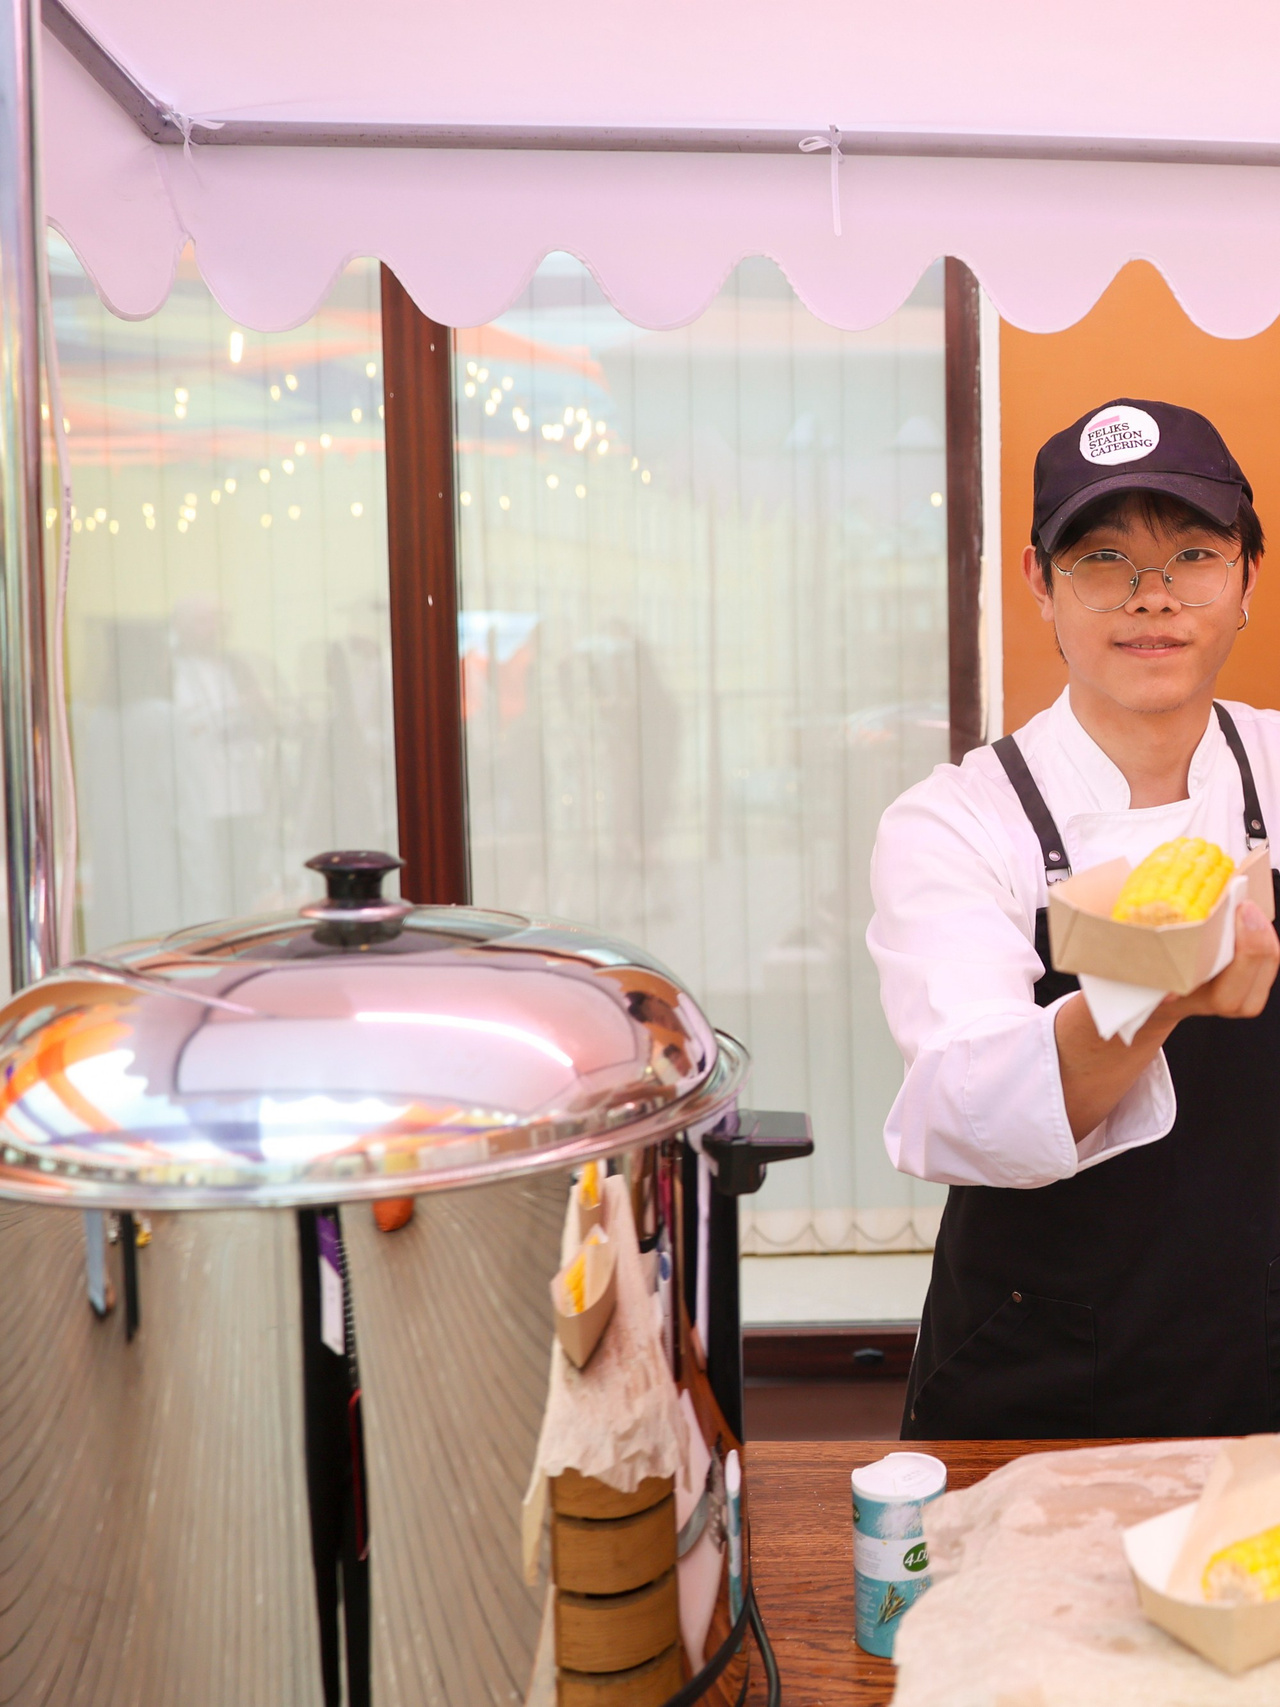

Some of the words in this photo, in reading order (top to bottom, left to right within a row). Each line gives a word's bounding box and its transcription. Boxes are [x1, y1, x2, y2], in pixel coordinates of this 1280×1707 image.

[1088, 423, 1130, 441] FELIKS
[1089, 430, 1142, 450] STATION
[1090, 439, 1153, 458] CATERING
